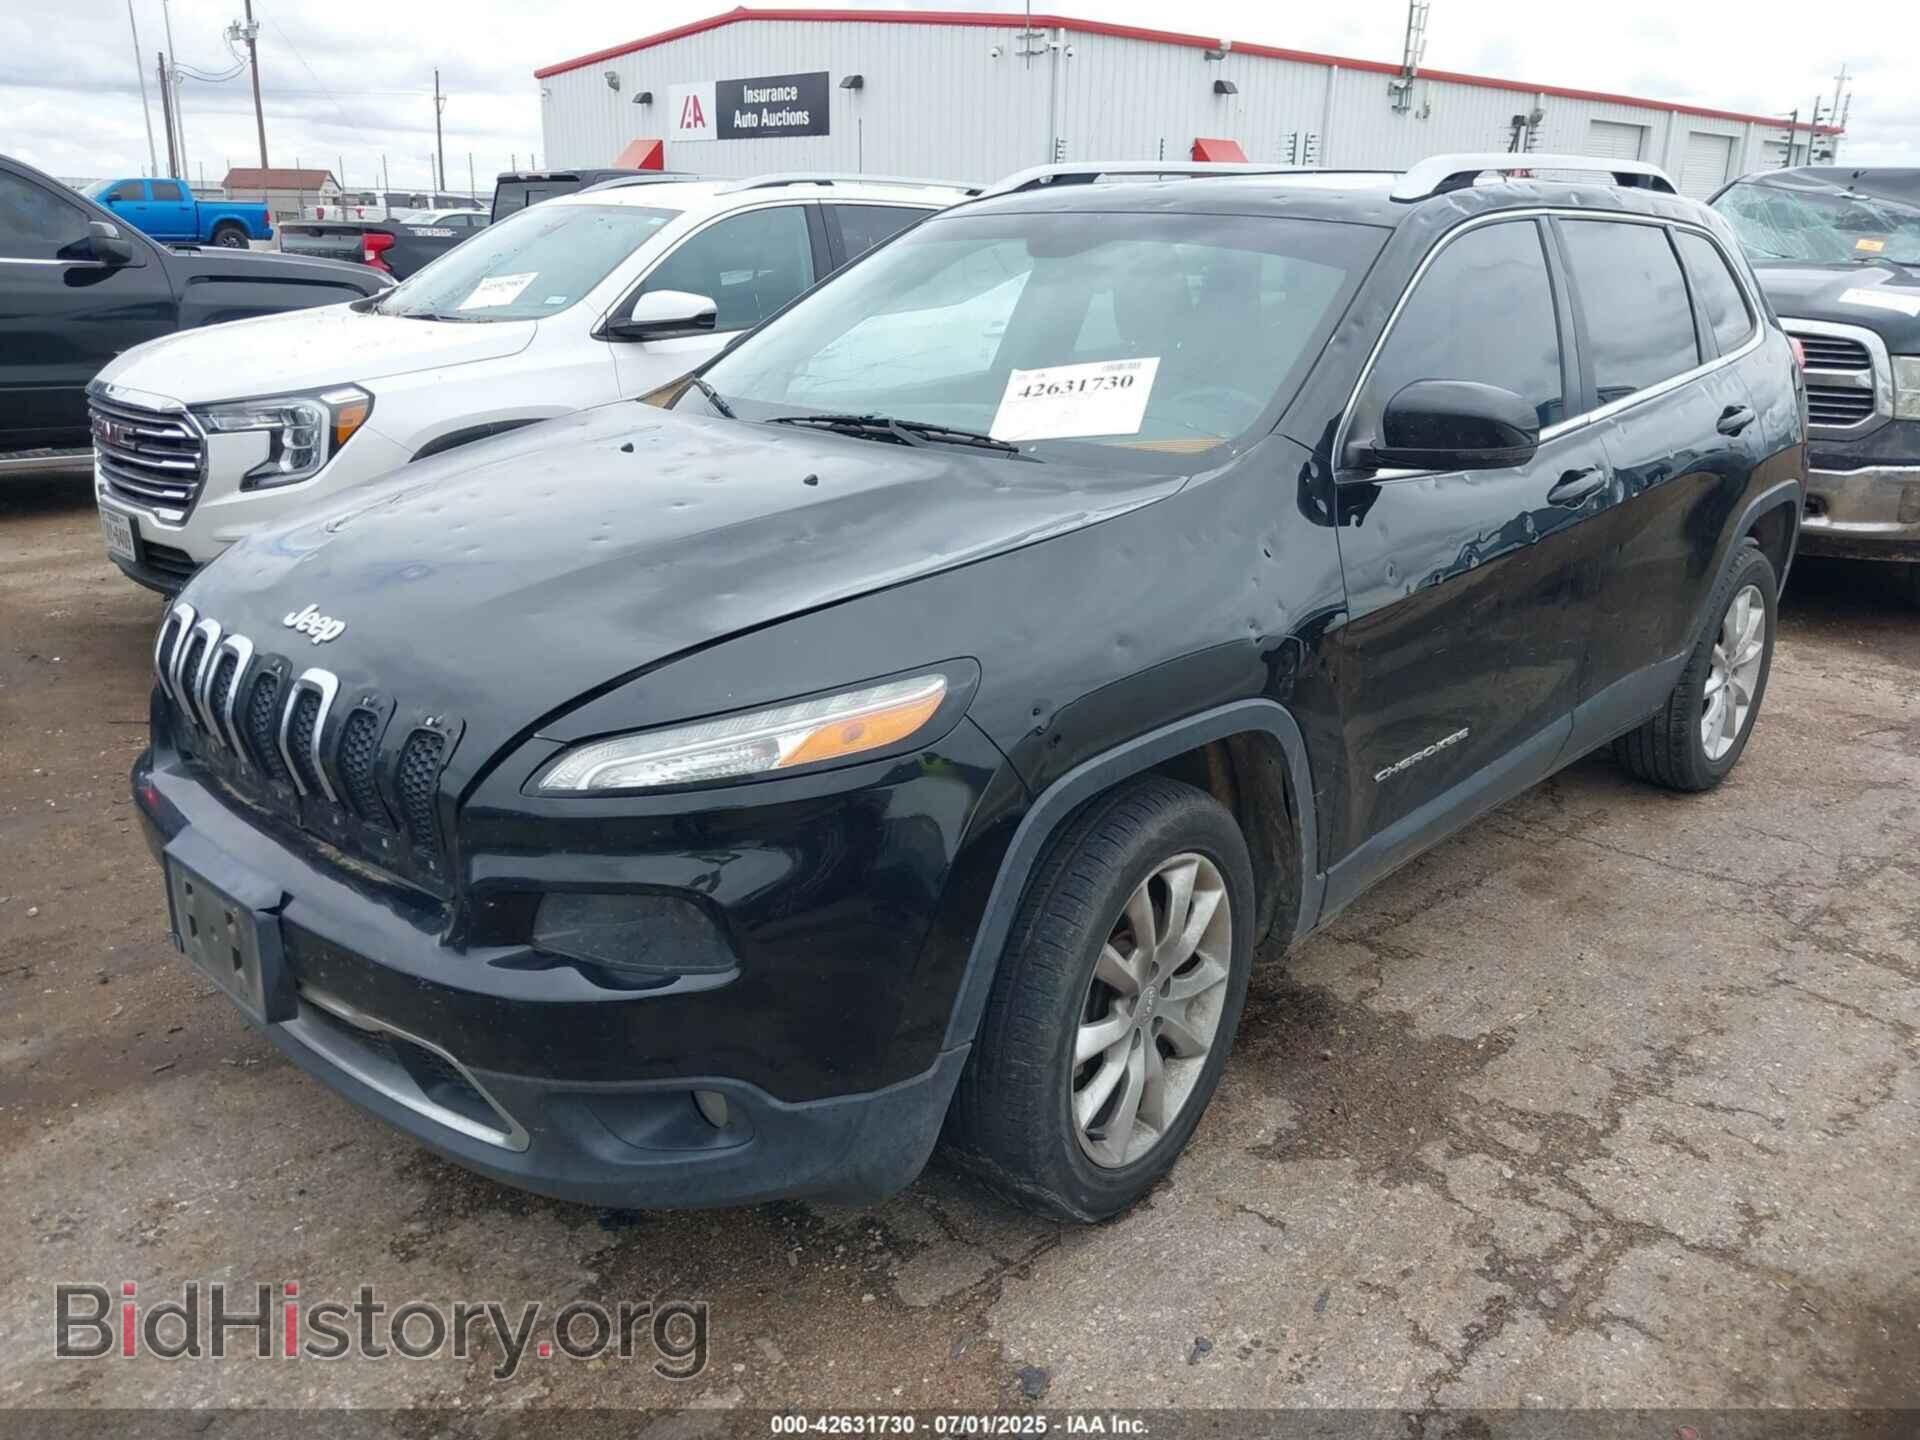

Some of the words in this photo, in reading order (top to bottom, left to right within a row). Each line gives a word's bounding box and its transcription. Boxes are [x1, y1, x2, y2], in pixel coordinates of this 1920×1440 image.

[743, 85, 798, 104] Insurance
[734, 109, 759, 128] Auto
[761, 106, 810, 127] Auctions
[1018, 374, 1135, 398] 42631730
[283, 603, 347, 645] Jeep
